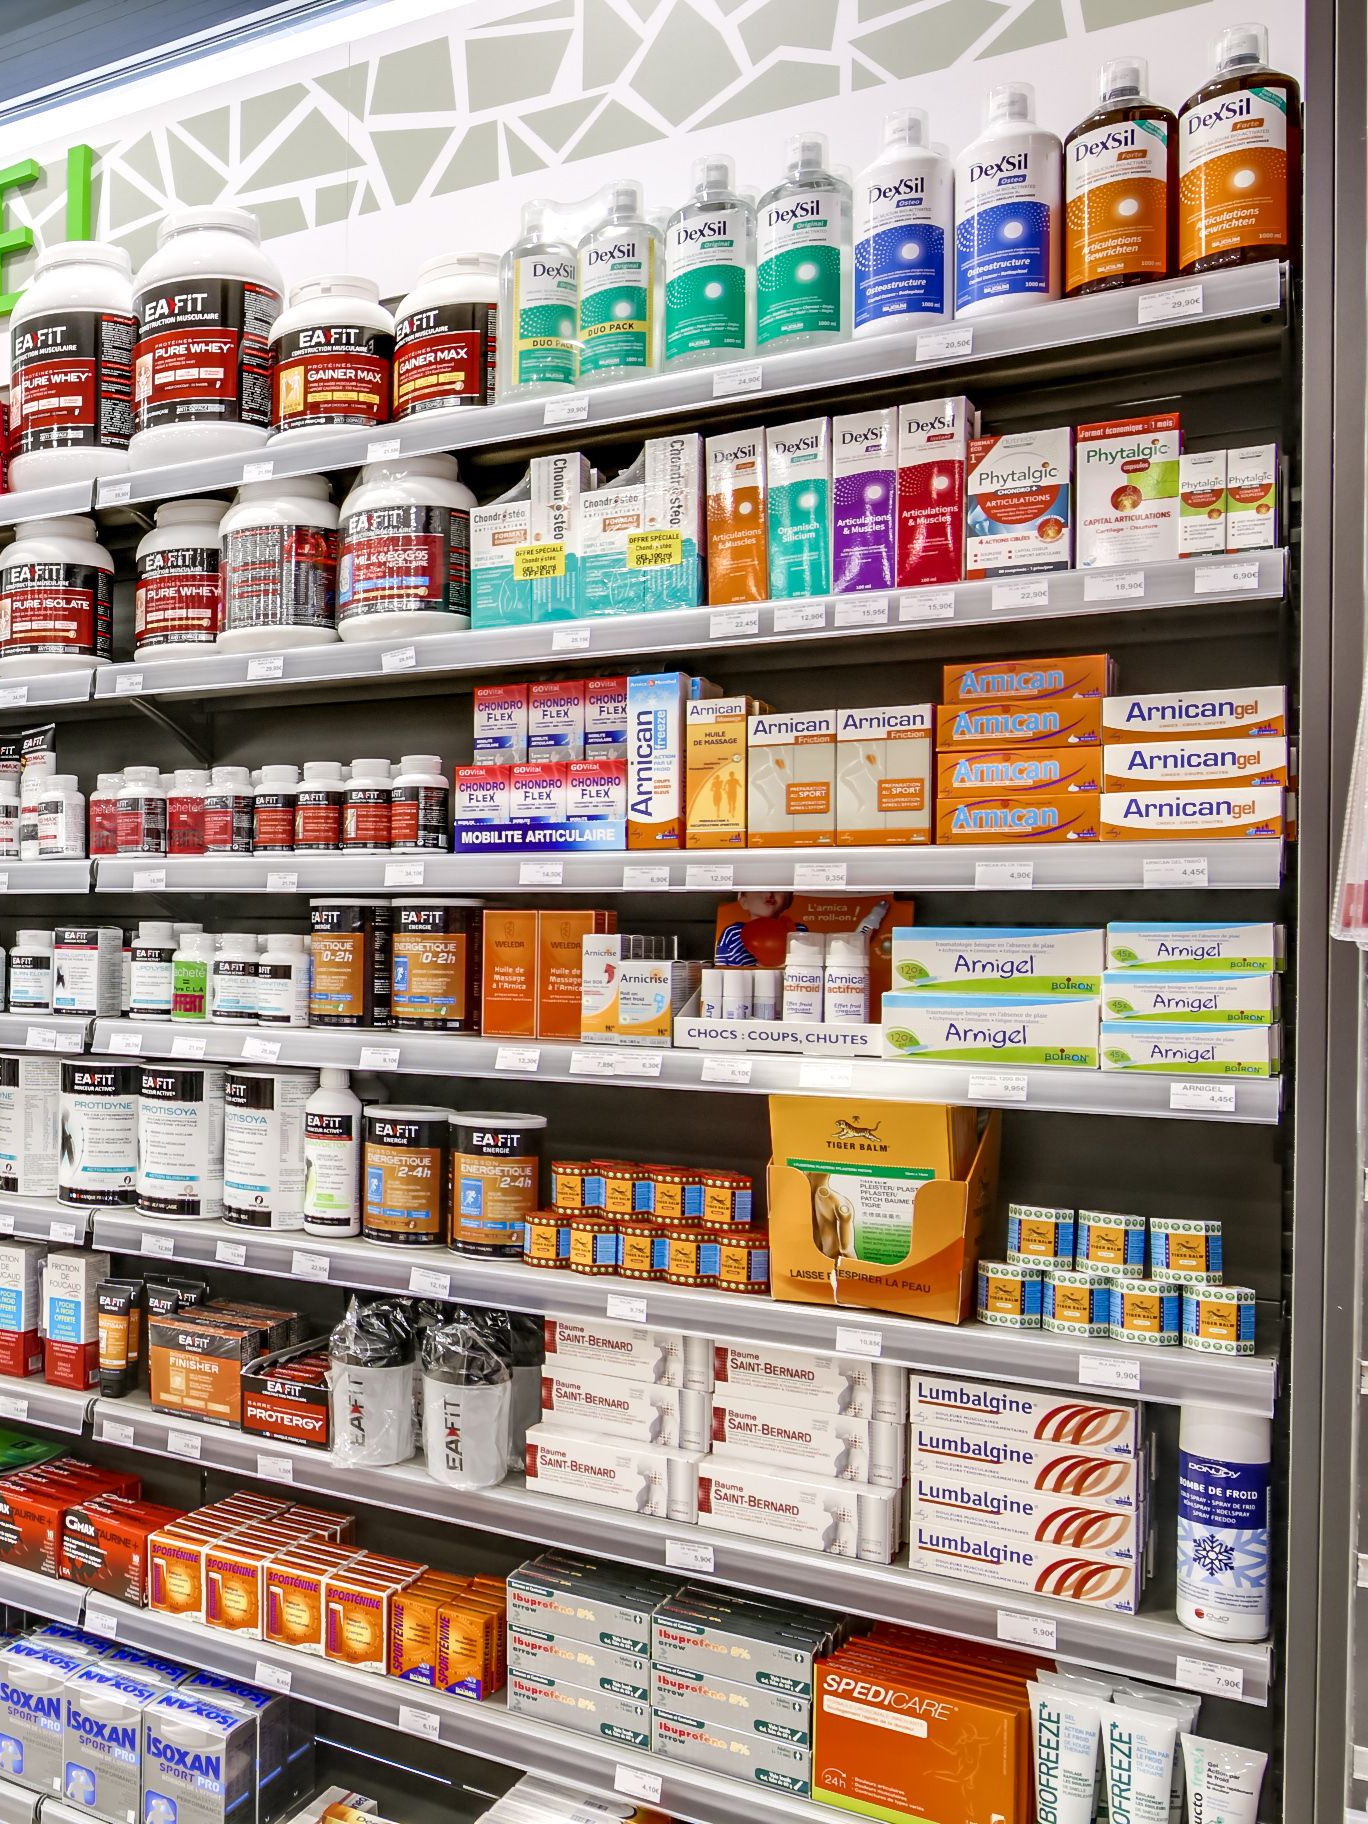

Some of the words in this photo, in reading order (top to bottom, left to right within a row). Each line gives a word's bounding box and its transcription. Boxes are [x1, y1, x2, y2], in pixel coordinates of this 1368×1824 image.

[1188, 98, 1250, 135] DexSil
[1236, 120, 1259, 129] Forte
[1075, 128, 1134, 161] DexSil
[970, 153, 1028, 182] DexSil
[1000, 176, 1024, 184] Osteo
[870, 177, 924, 203] DexSil
[768, 200, 820, 227] DexSil
[1196, 207, 1259, 230] Articulations
[796, 220, 824, 229] Original
[1199, 217, 1255, 237] Gewrichten
[677, 221, 727, 245] DexSil
[1082, 235, 1142, 255] Articulations
[588, 243, 635, 266] DexSil
[967, 257, 1030, 278] Osteostructure
[1171, 297, 1200, 309] 29,90€
[588, 324, 606, 335] DUO
[609, 321, 634, 333] PACK
[155, 346, 187, 358] PURE
[190, 342, 231, 354] WHEY
[945, 340, 971, 349] 20,50€
[307, 369, 354, 381] GAINER
[356, 371, 381, 383] MAX
[738, 376, 760, 385] 24,90€
[1086, 438, 1168, 464] Phytalgic
[979, 462, 1057, 489] Phytalgic
[1229, 471, 1272, 486] Phytalgic
[986, 494, 1050, 507] ARTICULATIONS
[1084, 516, 1113, 526] CAPITAL
[1115, 511, 1171, 523] ARTICULATIONS
[712, 528, 761, 542] Articulations
[778, 522, 819, 535] Organisch
[783, 531, 815, 543] Silicium
[1233, 571, 1258, 580] 6,90€
[1115, 581, 1143, 591] 18,90€
[1020, 590, 1048, 599] 22,90€
[13, 600, 39, 610] PURE
[43, 598, 89, 610] ISOLATE
[928, 602, 953, 610] 15,90€
[960, 670, 1064, 694] Arnican
[690, 702, 742, 715] Arnican
[753, 718, 830, 736] Arnican
[843, 711, 925, 730] Arnican
[954, 712, 1059, 736] Arnican
[654, 711, 667, 749] freeze
[704, 737, 738, 745] MASSAGE
[798, 735, 830, 743] Friction
[631, 710, 653, 817] Arnican
[459, 781, 505, 792] CHONDRO
[514, 779, 562, 790] CHONDRO
[571, 777, 621, 787] CHONDRO
[523, 790, 552, 800] FLEX
[581, 789, 610, 799] FLEX
[799, 790, 826, 798] SPORT
[891, 786, 920, 794] SPORT
[468, 793, 496, 803] FLEX
[461, 830, 523, 844] MOBILITE
[526, 829, 615, 843] ARTICULAIRE
[1182, 868, 1206, 876] 4,45€
[808, 904, 848, 912] L'arnica
[1157, 943, 1221, 960] Arnigel
[955, 955, 1034, 978] Arnigel
[494, 974, 525, 984] Massage
[621, 973, 668, 984] Arnicrise
[688, 1028, 737, 1040] CHOCS
[748, 1031, 802, 1043] COUPS,
[805, 1033, 868, 1045] CHUTES
[945, 1023, 1028, 1048] Arnigel
[1182, 1084, 1223, 1092] ARNIGEL
[75, 1101, 132, 1110] PROTIDYNE
[1209, 1095, 1233, 1103] 4,45€
[826, 1141, 855, 1152] TIGER
[860, 1142, 888, 1152] BALM
[461, 1164, 532, 1175] ENERGETIQUE
[790, 1268, 824, 1280] LAISSE
[886, 1278, 898, 1286] LA
[902, 1281, 930, 1292] PEAU
[559, 1322, 584, 1333] Baume
[559, 1330, 633, 1352] SAINT-BERNARD
[731, 1349, 759, 1360] Baume
[169, 1356, 219, 1373] FINISHER
[731, 1358, 815, 1380] SAINT-BERNARD
[1115, 1371, 1138, 1380] 9,90€
[556, 1380, 581, 1390] Baume
[556, 1388, 630, 1410] SAINT-BERNARD
[919, 1382, 1033, 1414] Lumbalgine
[247, 1408, 323, 1431] PROTERGY
[919, 1430, 1033, 1464] Lumbalgine
[1180, 1477, 1205, 1495] BOMBE
[1209, 1486, 1222, 1496] DE
[1226, 1489, 1258, 1500] FROID
[919, 1480, 1033, 1516] Lumbalgine
[208, 1558, 256, 1579] SPORTÉNINE
[268, 1571, 319, 1592] SPORTÉNINE
[328, 1587, 381, 1610] SPORTÉNINE
[1033, 1627, 1054, 1637] 5,90€
[1216, 1677, 1240, 1689] 7,90€
[823, 1674, 950, 1721] SPEDICARE
[8, 1706, 38, 1723] SPORT
[41, 1719, 61, 1732] PRO
[825, 1774, 846, 1789] 24h
